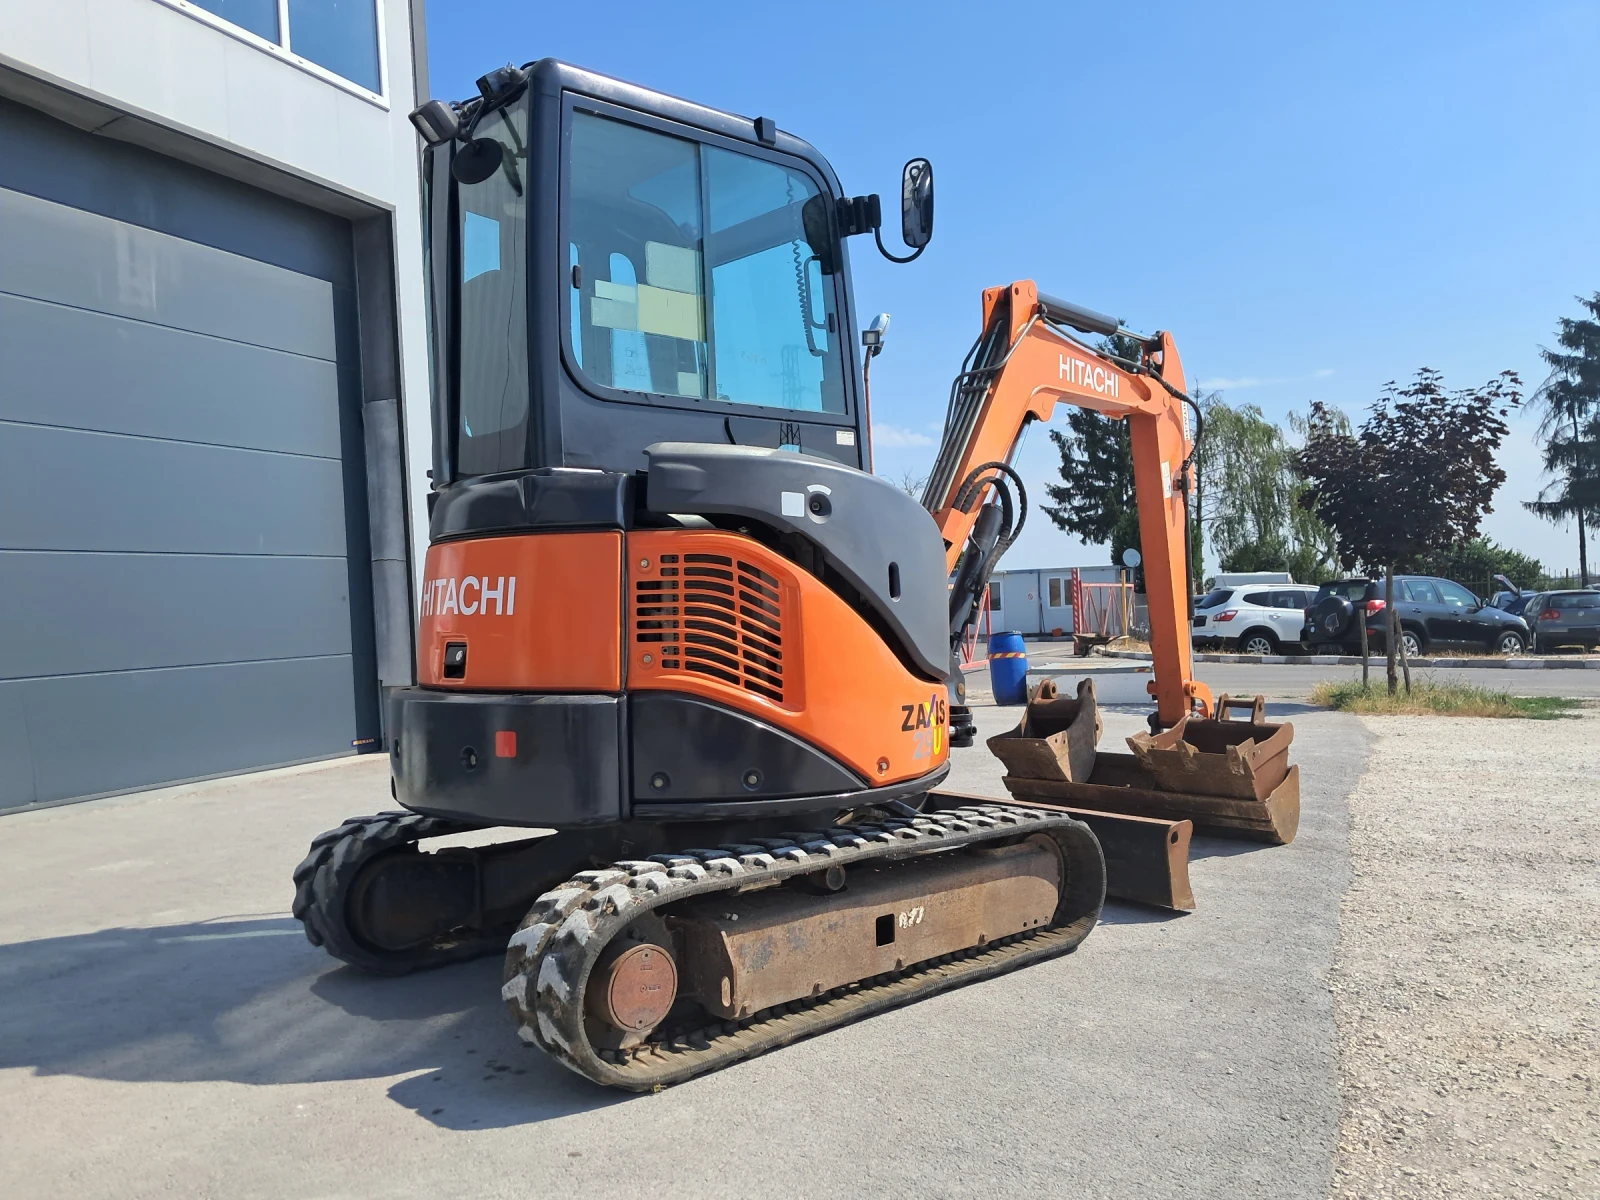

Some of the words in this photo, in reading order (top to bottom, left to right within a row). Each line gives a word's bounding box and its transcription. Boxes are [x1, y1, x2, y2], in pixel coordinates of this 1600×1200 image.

[1059, 353, 1119, 398] HITACHI
[422, 575, 516, 617] HITACHI
[901, 694, 946, 732] ZAXIS
